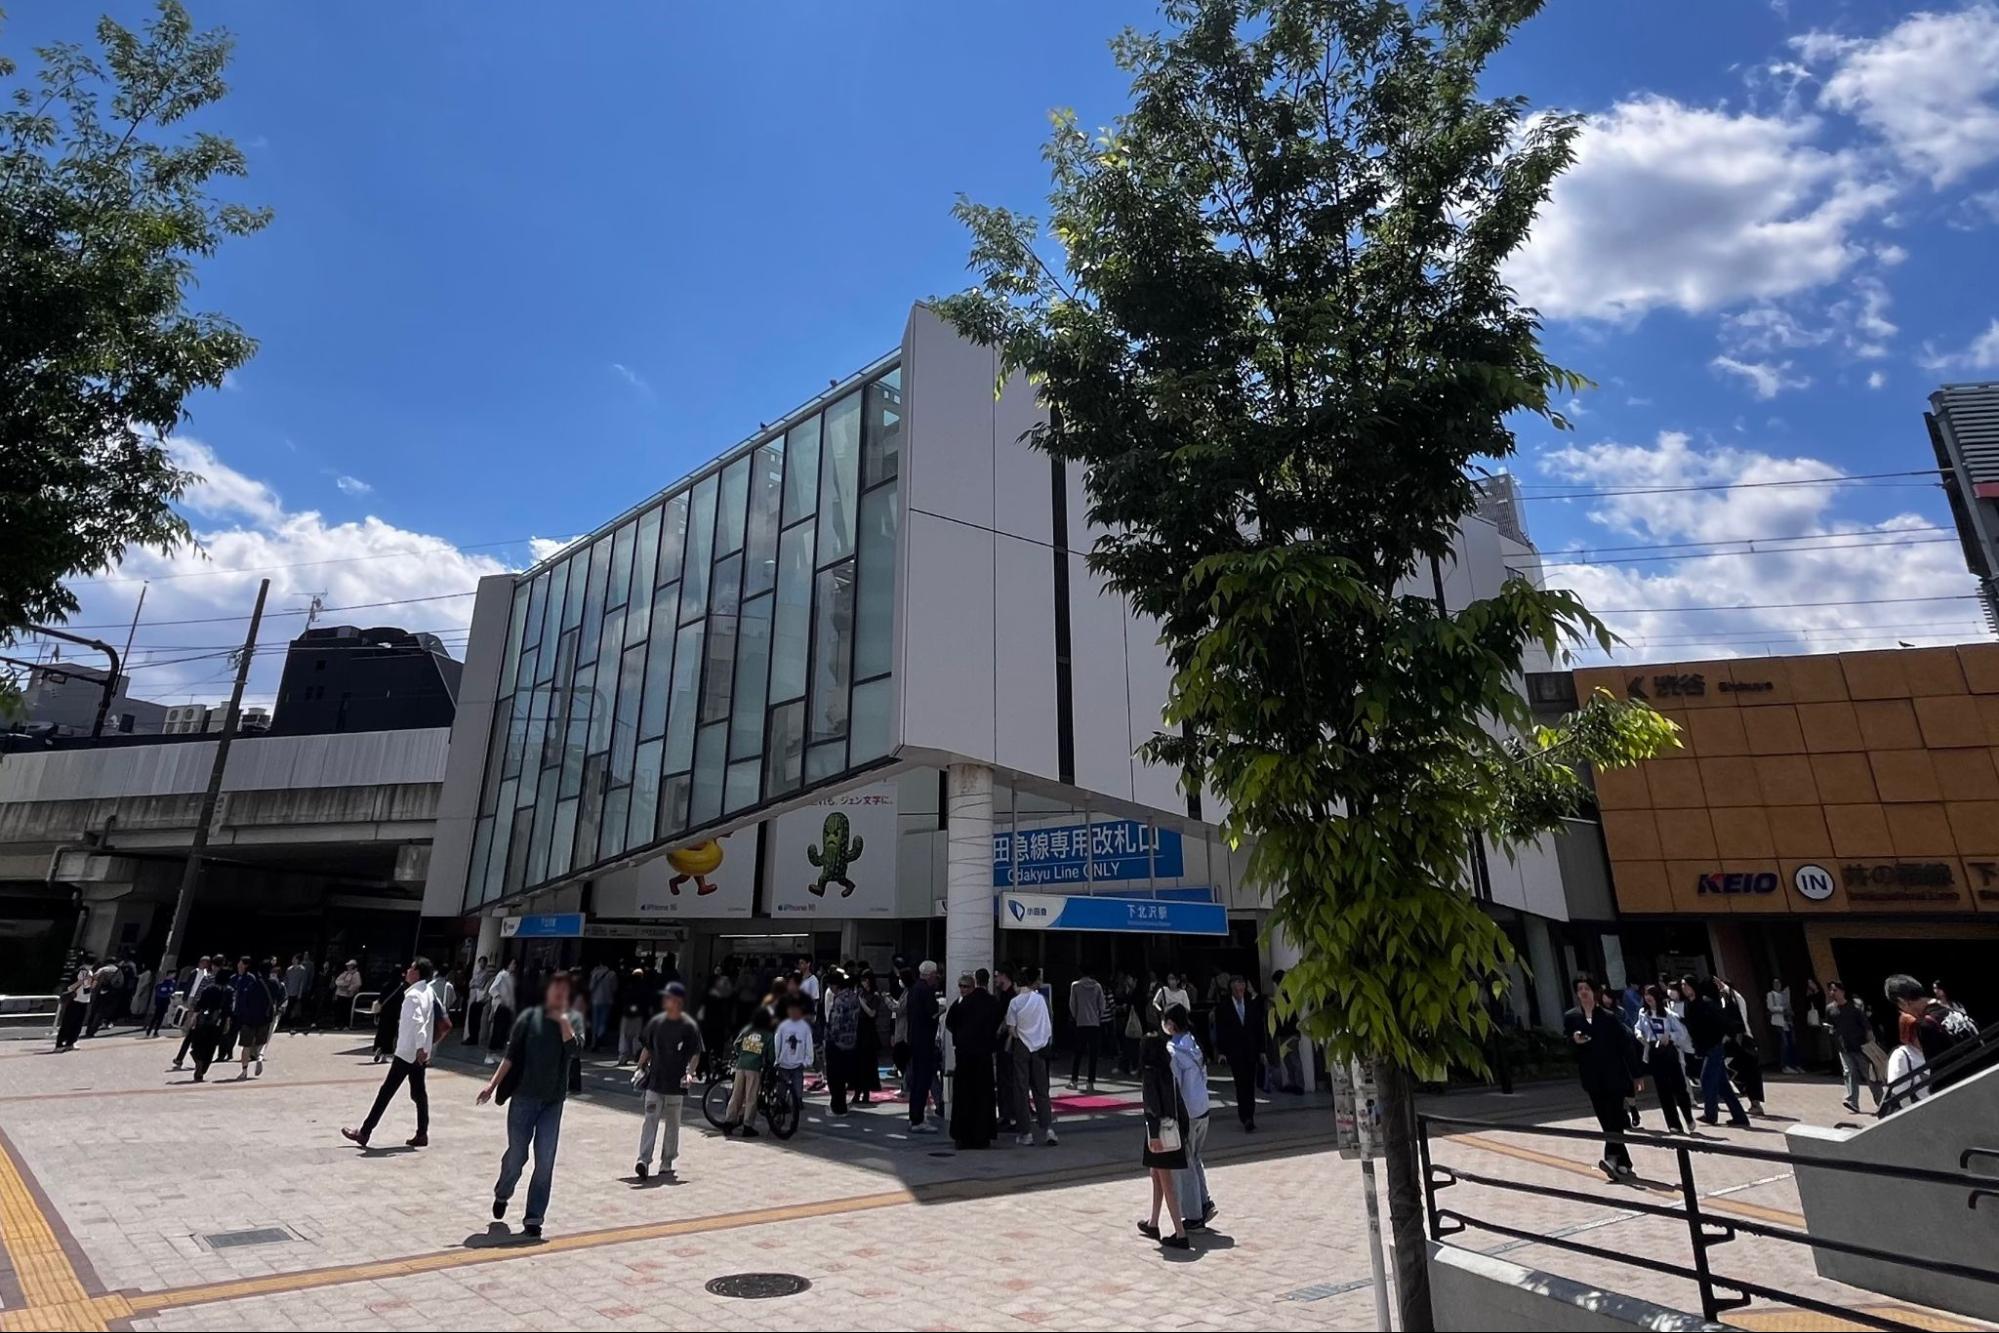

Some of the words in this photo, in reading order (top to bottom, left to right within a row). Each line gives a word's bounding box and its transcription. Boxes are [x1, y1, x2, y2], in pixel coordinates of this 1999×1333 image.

[1007, 867, 1050, 884] Odakyu
[1054, 866, 1080, 880] Line
[1083, 862, 1120, 879] ONLY
[1801, 873, 1828, 891] IN
[1697, 873, 1777, 896] KEIO
